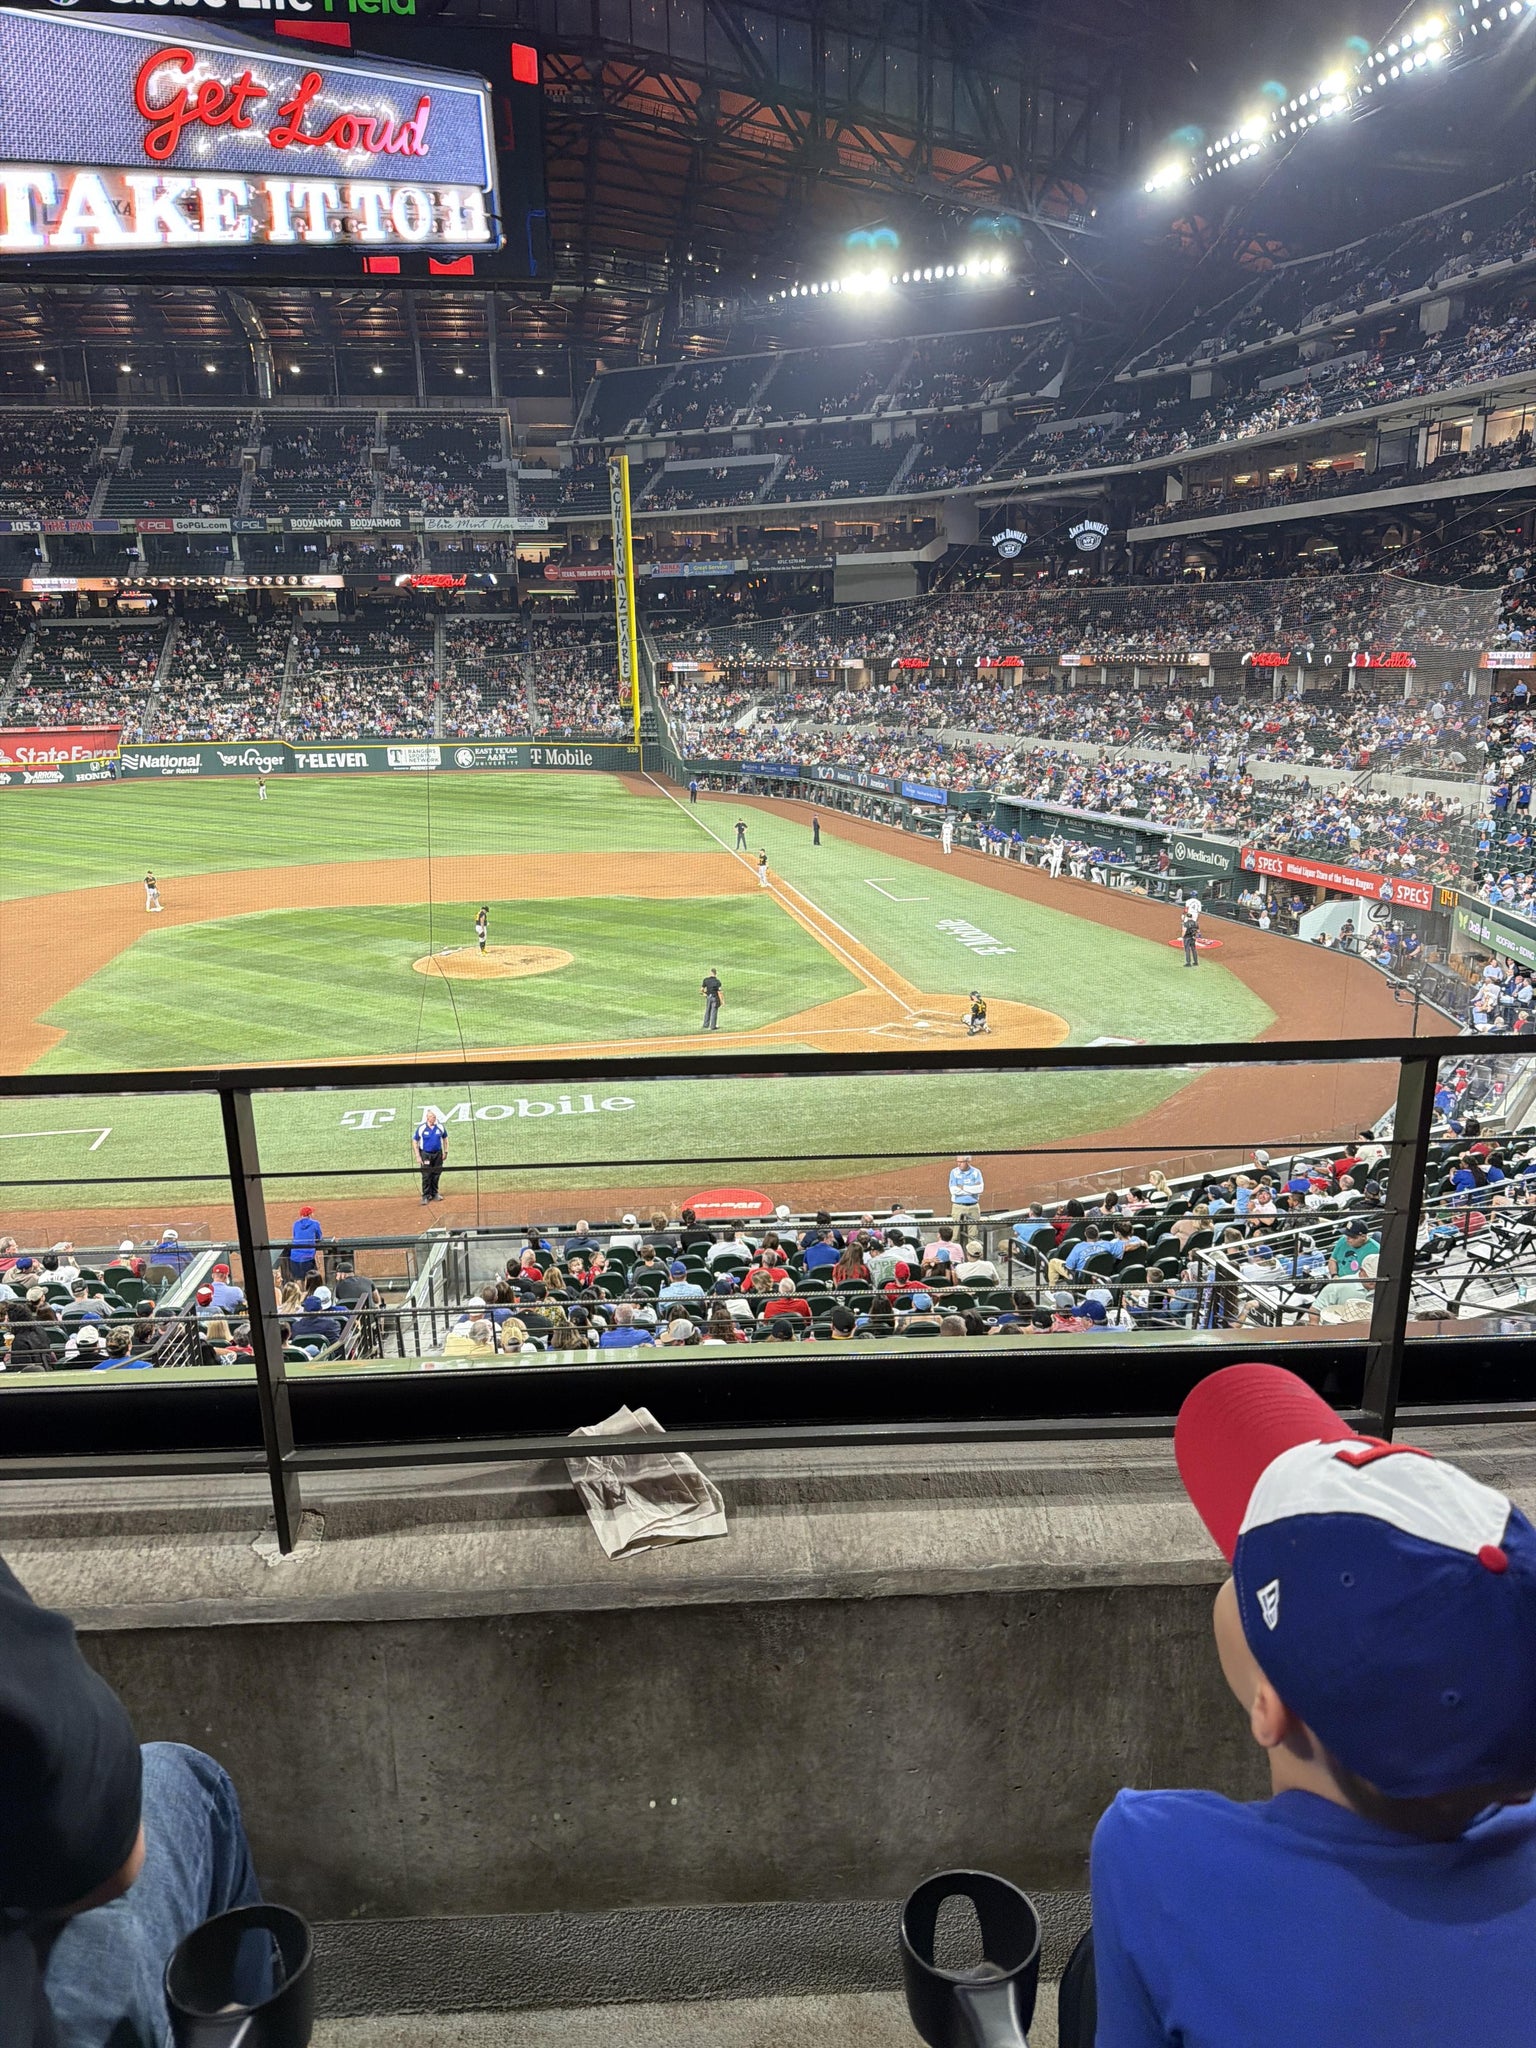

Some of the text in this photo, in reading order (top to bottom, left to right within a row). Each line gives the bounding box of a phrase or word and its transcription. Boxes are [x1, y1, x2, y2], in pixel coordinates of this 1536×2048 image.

[136, 47, 430, 159] Get Loud
[0, 171, 250, 246] TAKE
[261, 180, 339, 240] IT
[347, 183, 433, 241] TO
[11, 521, 94, 532] 105.3 THE FAN
[147, 521, 171, 530] PGL
[176, 521, 228, 529] GoPGL.com
[241, 521, 264, 529] PGL
[290, 518, 343, 528] BODYARMOR
[350, 518, 402, 528] BODYARMOR
[427, 518, 453, 530] Blue
[457, 519, 488, 529] Mint
[491, 518, 515, 529] Thai
[613, 491, 624, 575] CHIKIN
[1068, 524, 1084, 539] JACK
[992, 533, 1006, 547] JACK
[16, 746, 118, 762] State Farm
[475, 747, 493, 755] EAST
[487, 753, 506, 761] A&M
[530, 748, 593, 766] T Mobile
[139, 753, 201, 768] National
[239, 748, 285, 774] Kroger
[295, 752, 368, 769] 7-ELEVEN
[1186, 847, 1230, 871] Medical City
[1257, 856, 1283, 874] SPEC'S
[1334, 873, 1342, 882] the
[1355, 877, 1374, 890] Rangers
[1397, 885, 1430, 905] SPEC'S
[340, 1094, 636, 1130] T Mobile
